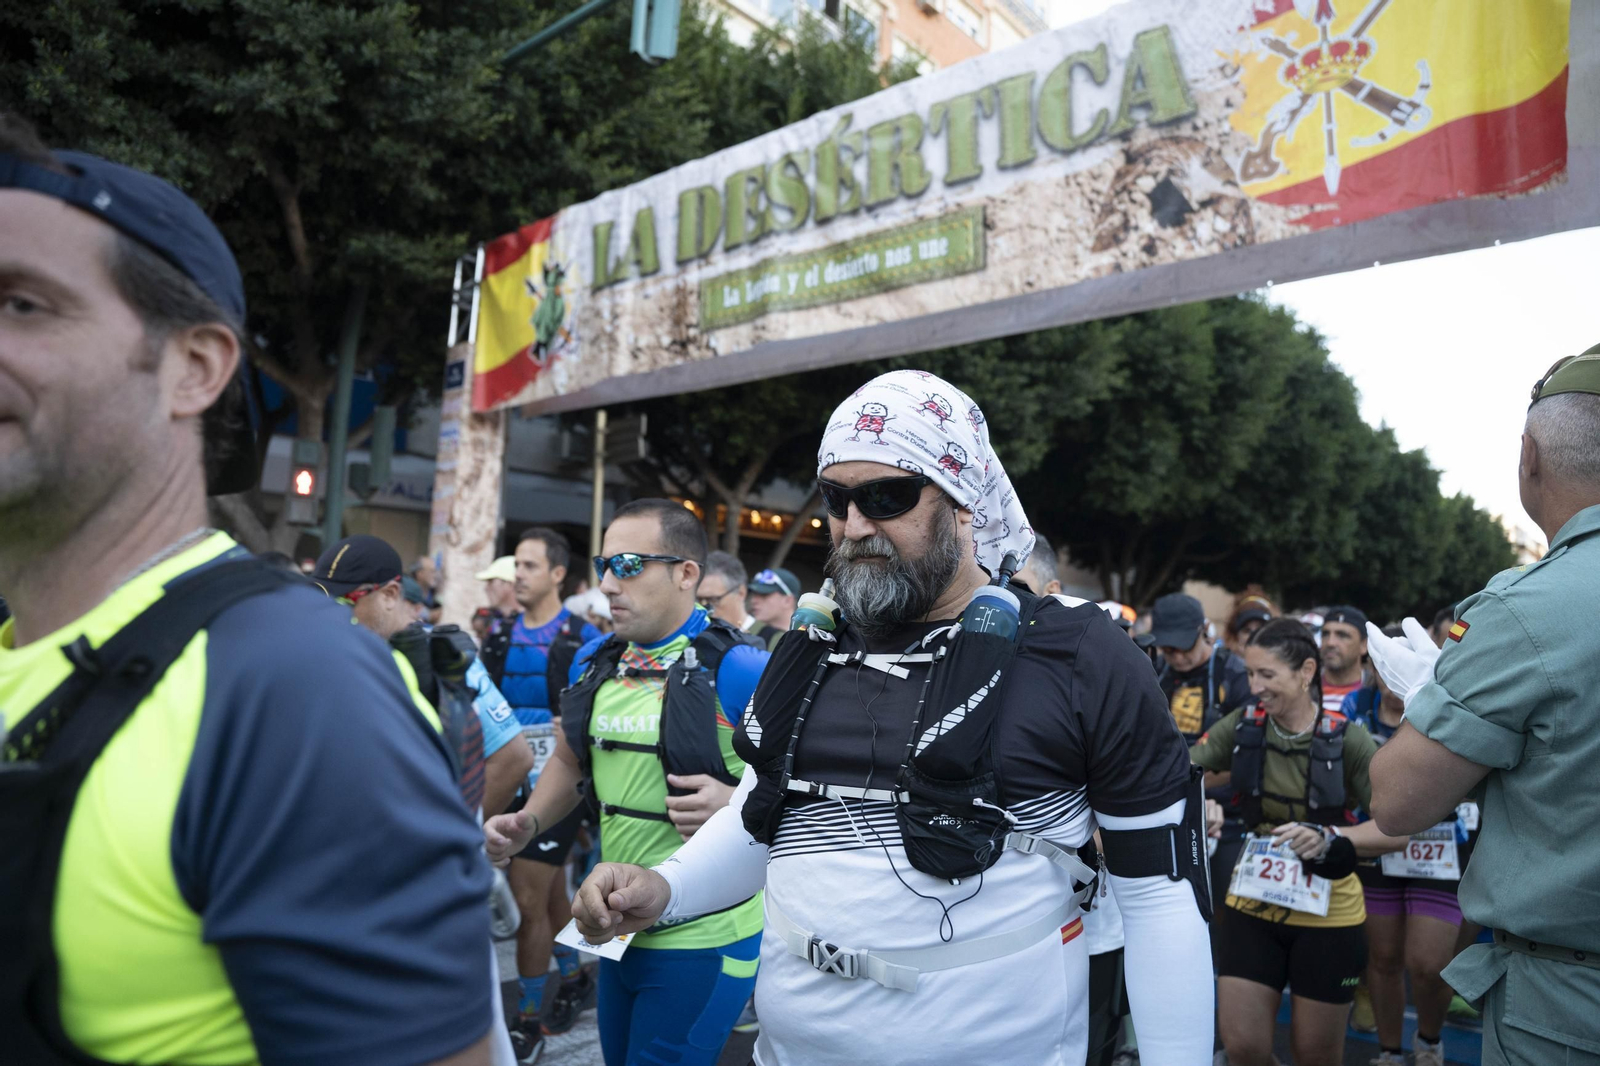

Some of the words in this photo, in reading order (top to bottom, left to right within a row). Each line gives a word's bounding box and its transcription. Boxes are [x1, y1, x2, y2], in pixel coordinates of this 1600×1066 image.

[592, 206, 660, 294] LA
[675, 24, 1198, 265] DESÉRTICA
[723, 285, 740, 308] La
[787, 272, 799, 295] y
[804, 263, 819, 288] el
[823, 251, 880, 284] desierto
[885, 244, 912, 268] nos
[918, 236, 949, 260] une
[886, 426, 909, 441] Contra
[909, 438, 938, 460] Duchenne
[905, 428, 928, 446] Héroes
[1191, 840, 1199, 866] CRIVIT
